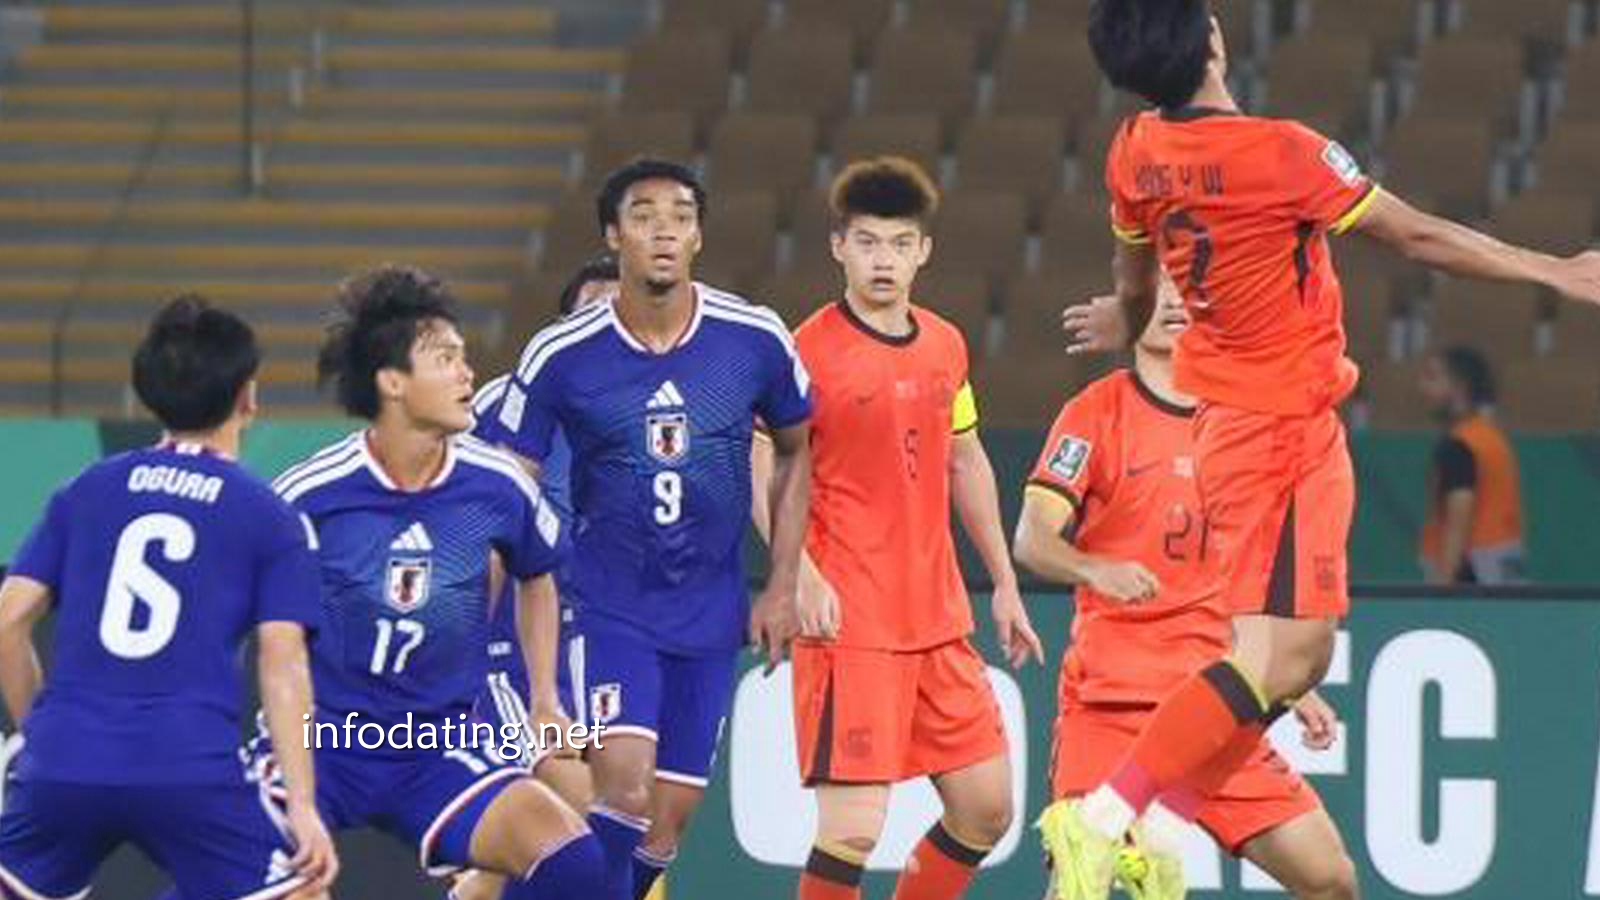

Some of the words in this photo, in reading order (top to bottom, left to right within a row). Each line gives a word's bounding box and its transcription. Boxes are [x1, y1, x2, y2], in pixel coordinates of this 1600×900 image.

[127, 463, 224, 504] OGURA
[653, 470, 682, 526] 9
[1163, 503, 1210, 563] 21
[99, 512, 196, 659] 6
[369, 617, 426, 675] 17
